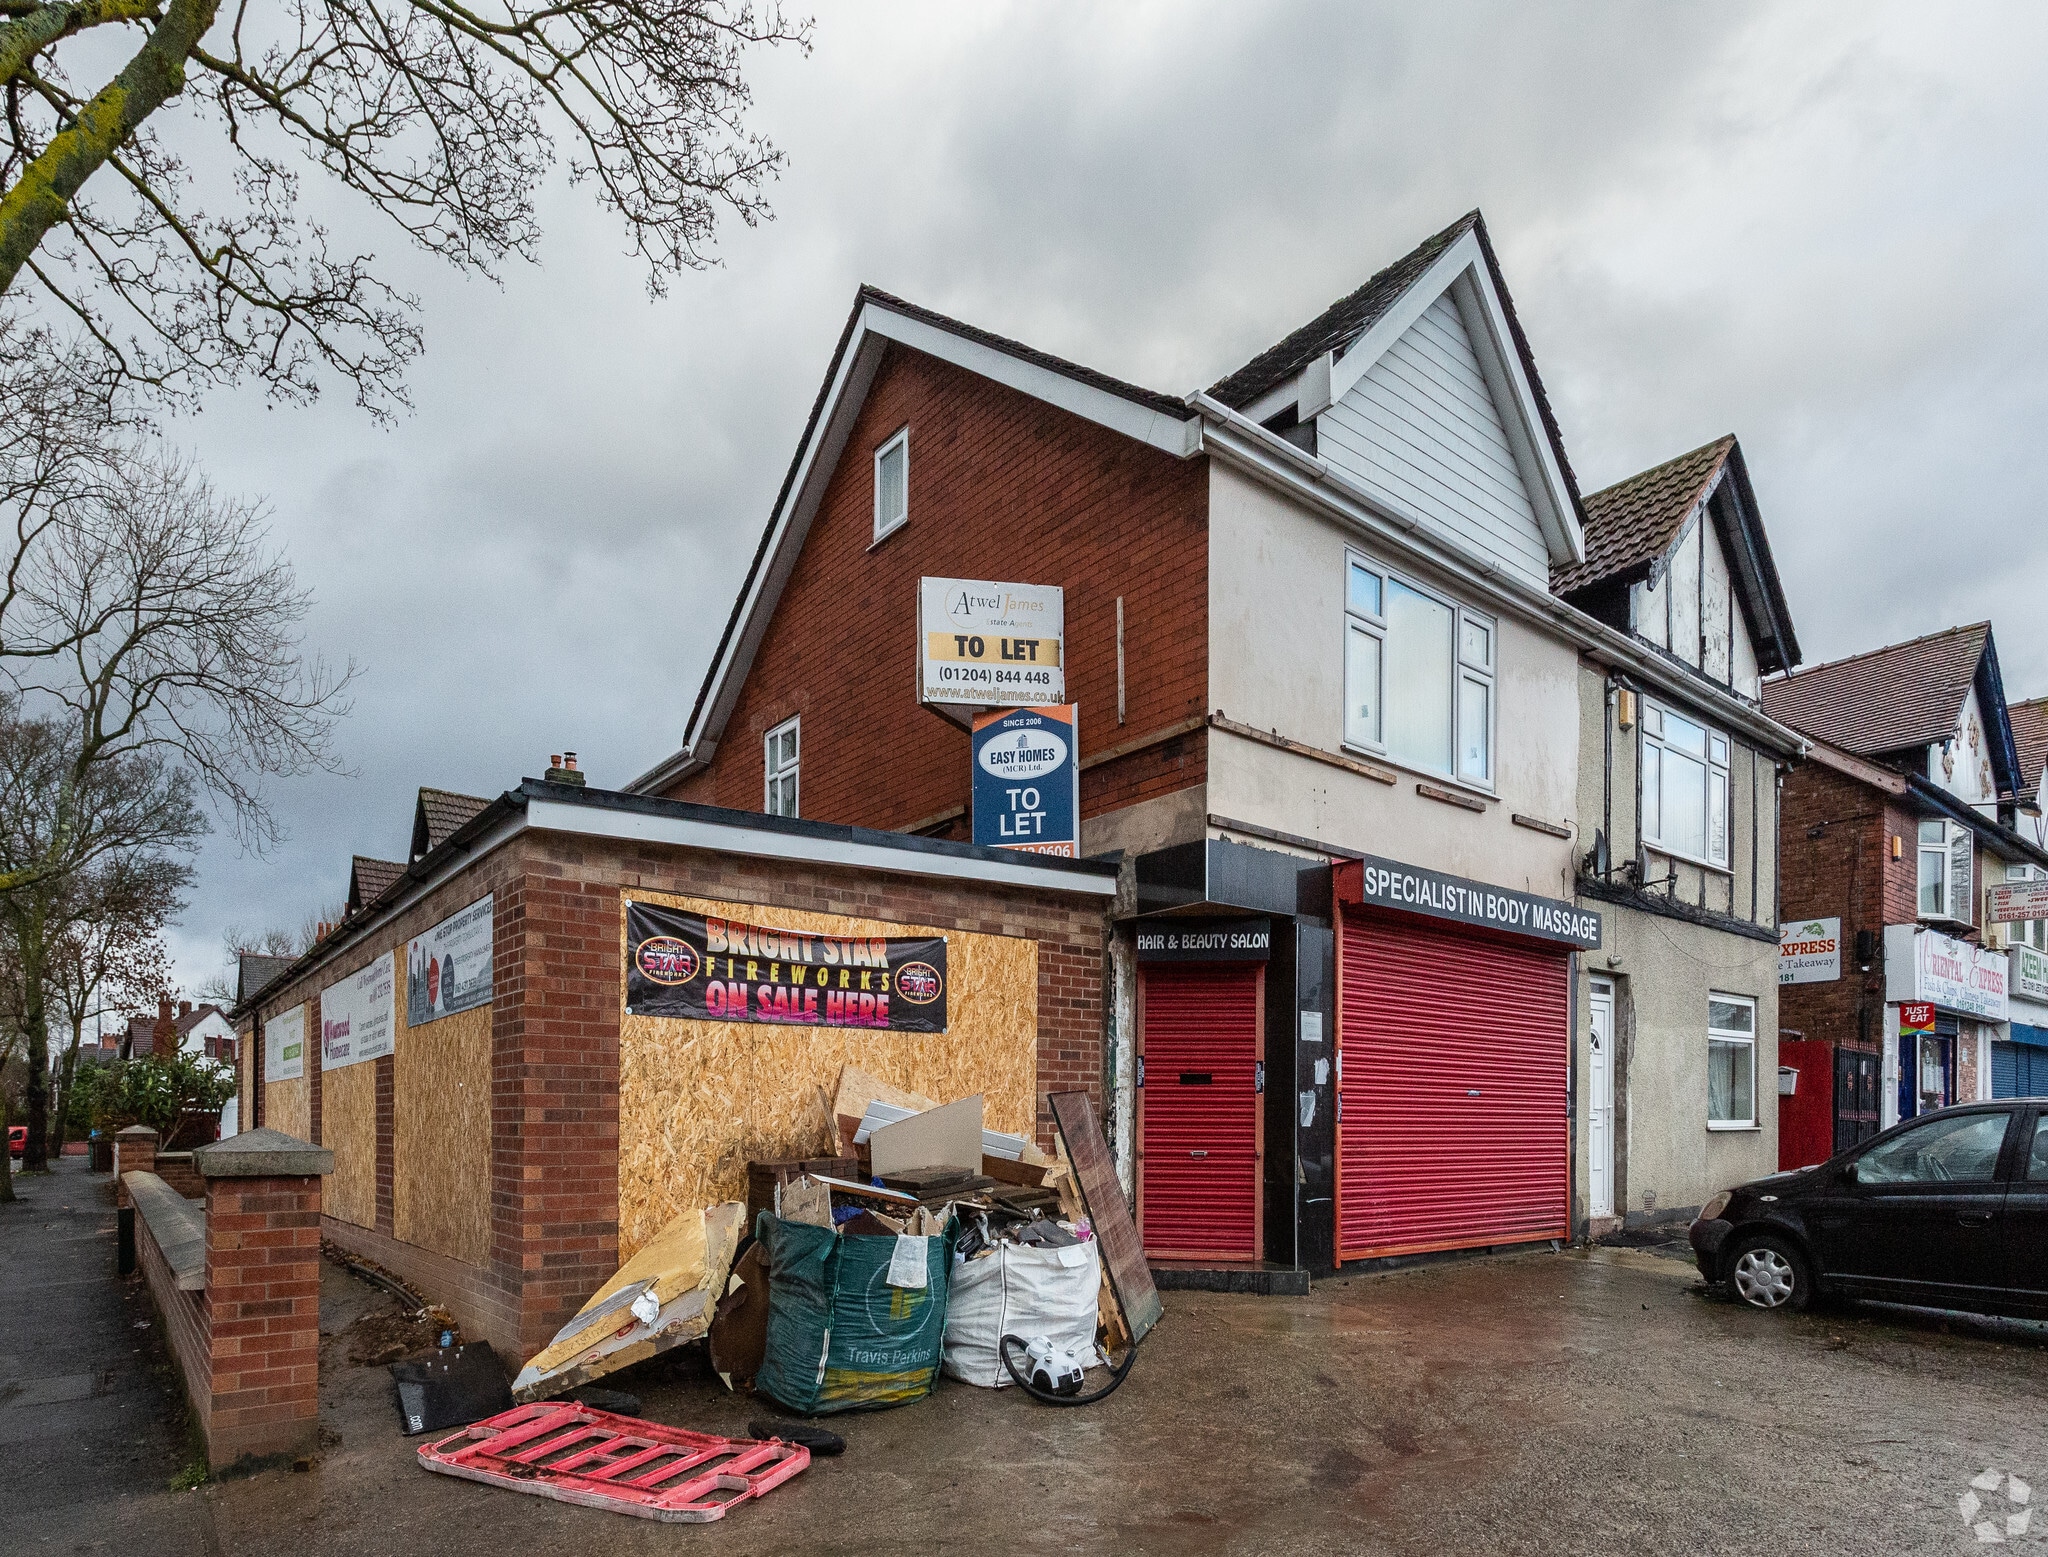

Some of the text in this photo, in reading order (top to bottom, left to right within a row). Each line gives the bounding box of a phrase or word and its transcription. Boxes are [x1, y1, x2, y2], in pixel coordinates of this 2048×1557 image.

[1001, 593, 1044, 619] James
[954, 634, 1040, 661] TO LET
[939, 666, 1050, 685] (01204) 844 448
[1003, 719, 1024, 728] SINCE
[990, 748, 1055, 764] EASY HOMES
[1003, 764, 1026, 774] (MCR)
[1006, 787, 1040, 811] TO
[1000, 812, 1046, 836] LET
[1364, 866, 1598, 941] SPECIALIST IN BODY MASSAGE
[650, 942, 684, 954] BRIGHT
[706, 918, 890, 968] BRIGHT STAR
[1138, 933, 1269, 950] HAIR & BEAUTY SALON
[1778, 938, 1836, 956] XPRESS
[644, 952, 692, 972] STAR
[1785, 958, 1835, 970] Takeaway
[706, 956, 890, 992] FIREWORKS
[906, 968, 932, 977] BRIGHT
[1779, 973, 1794, 982] 181
[901, 976, 936, 992] STAR
[706, 980, 890, 1027] ON SALE HERE
[1904, 1006, 1930, 1016] JUST
[1910, 1014, 1930, 1022] EAT
[848, 1346, 931, 1364] Travis Perkins
